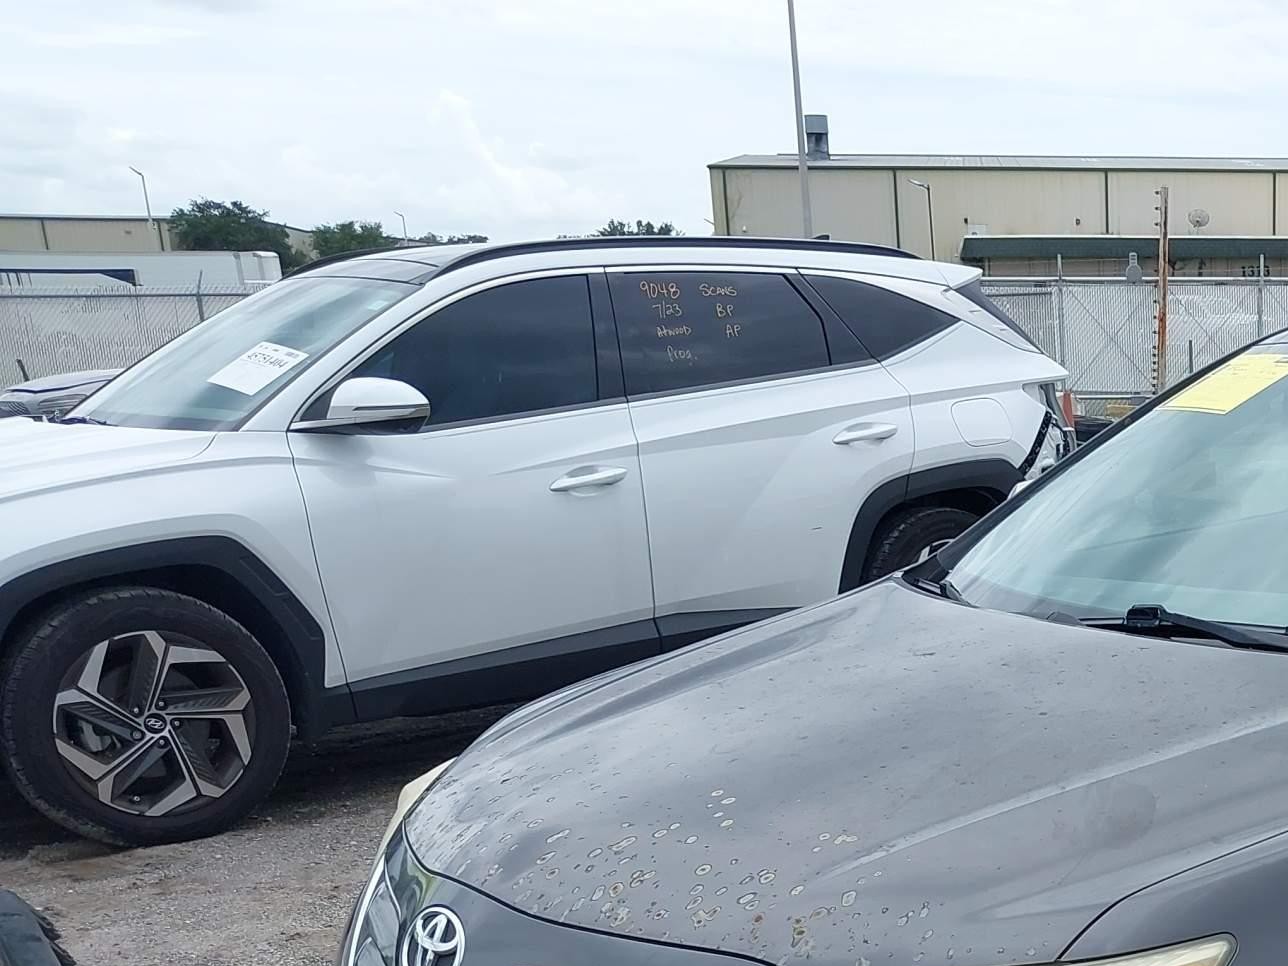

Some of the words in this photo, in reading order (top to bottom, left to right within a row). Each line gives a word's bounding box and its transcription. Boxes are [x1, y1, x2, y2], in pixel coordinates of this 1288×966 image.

[640, 281, 680, 299] 9048
[699, 283, 737, 296] SCANS
[652, 300, 682, 319] 7/23
[716, 303, 734, 318] BP
[726, 324, 741, 338] AP
